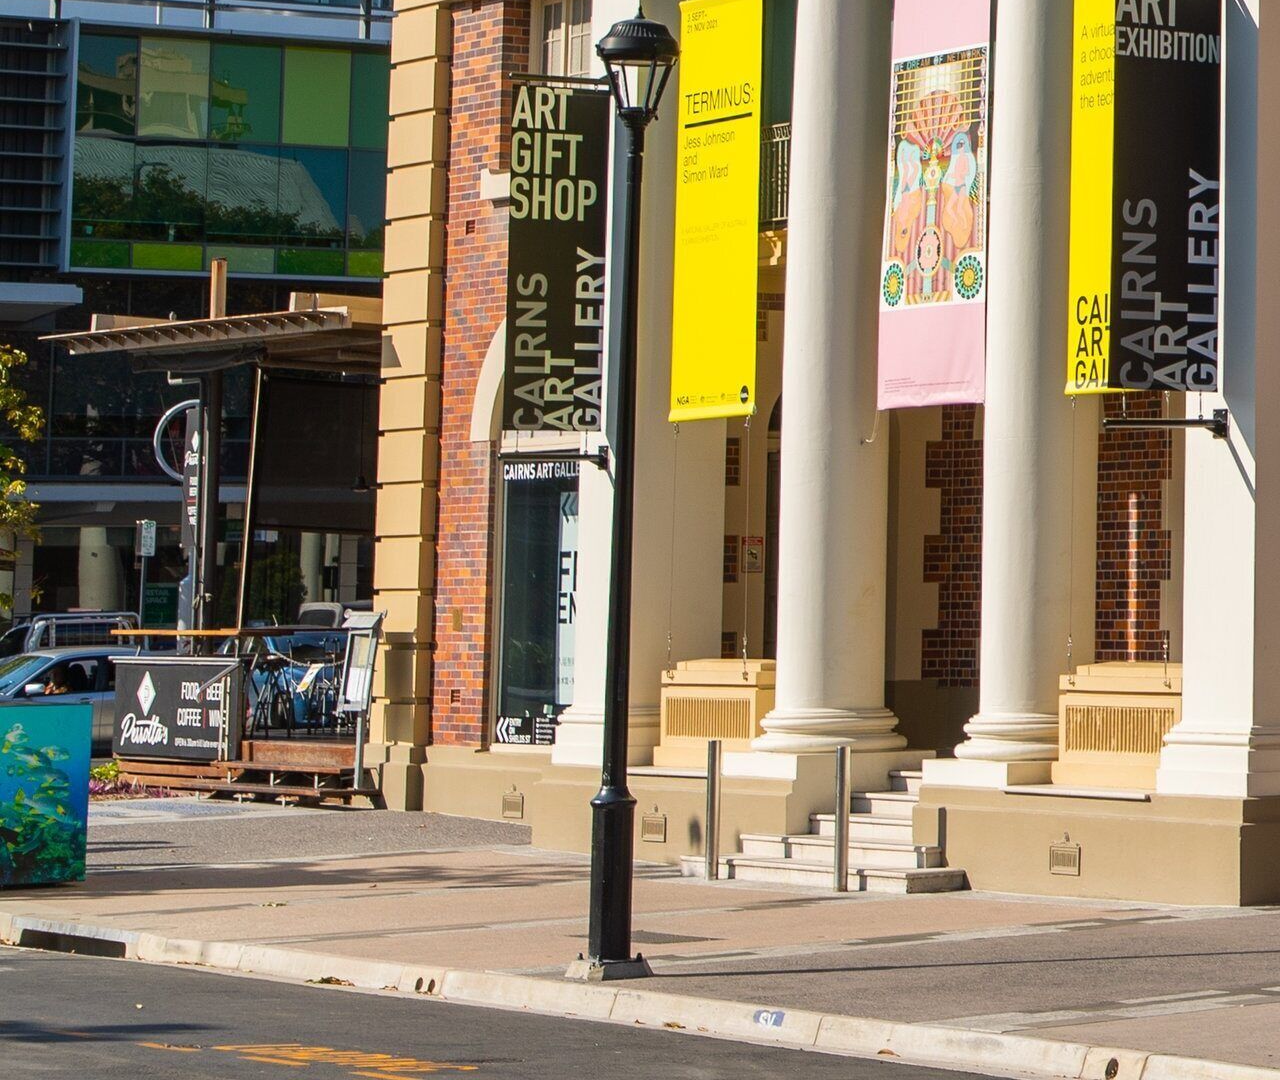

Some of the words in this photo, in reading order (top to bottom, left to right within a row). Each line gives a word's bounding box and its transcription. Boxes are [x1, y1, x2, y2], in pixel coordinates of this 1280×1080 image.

[694, 22, 705, 31] NOV
[1081, 25, 1088, 40] A
[1080, 51, 1087, 63] a
[1115, 26, 1220, 64] EXHIBITION
[906, 58, 930, 70] DREAM
[933, 55, 943, 65] OF
[947, 46, 987, 63] NETWORKS
[511, 86, 574, 130] ART
[685, 82, 755, 115] TERMINUS:
[1080, 94, 1094, 110] the
[684, 136, 701, 150] Jess
[703, 130, 736, 146] Johnson
[511, 131, 584, 176] GIFT
[683, 152, 698, 167] and
[683, 169, 707, 184] Simon
[709, 164, 728, 179] Ward
[509, 176, 597, 222] SHOP
[1186, 168, 1219, 392] GALLERY
[1120, 198, 1157, 389] CAIRNS
[572, 246, 605, 432] GALLERY
[1076, 325, 1110, 358] AR
[1153, 291, 1188, 391] ART
[513, 273, 548, 430] CAIRNS
[543, 350, 575, 431] ART
[676, 395, 690, 406] NGA
[504, 462, 536, 480] CAIRNS
[536, 461, 555, 479] ART
[144, 522, 154, 530] 3P
[181, 682, 200, 701] FOOD
[177, 708, 202, 727] COFFEE
